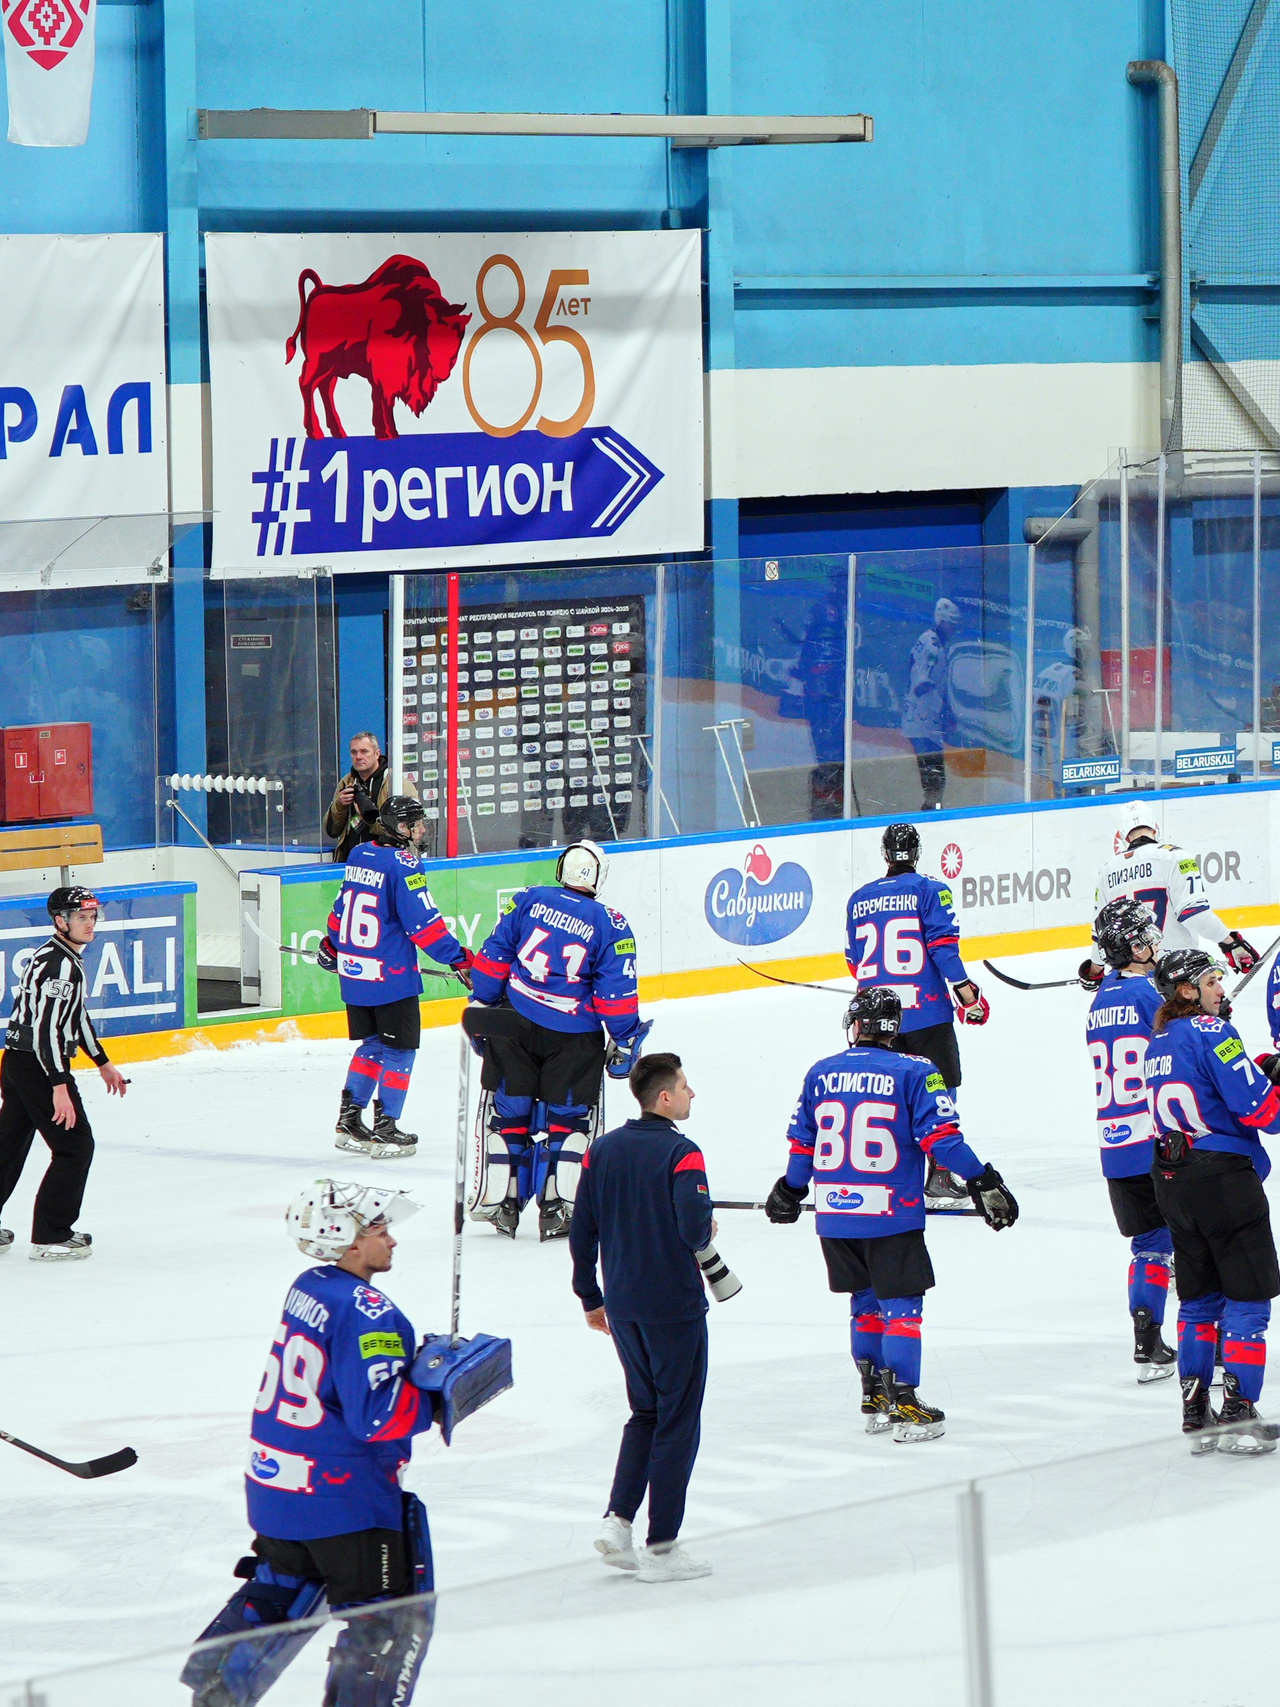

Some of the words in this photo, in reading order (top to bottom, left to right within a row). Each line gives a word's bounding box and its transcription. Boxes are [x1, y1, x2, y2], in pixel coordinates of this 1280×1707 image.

[556, 296, 592, 317] лет
[462, 254, 597, 438] 85
[1063, 763, 1120, 779] BELARUSKALI
[1176, 750, 1235, 769] BELARUSKALI
[896, 851, 909, 861] 26
[962, 867, 1071, 909] BREMOR
[1107, 862, 1153, 889] ЕЛИЗАРОВ
[711, 878, 805, 928] Савушкин
[852, 893, 918, 920] ВЕРЕМЕЕНКО
[339, 889, 379, 949] 16
[518, 927, 586, 983] 41
[855, 917, 925, 981] 26
[51, 981, 71, 998] 50
[880, 1020, 894, 1031] 86
[813, 1100, 899, 1173] 86
